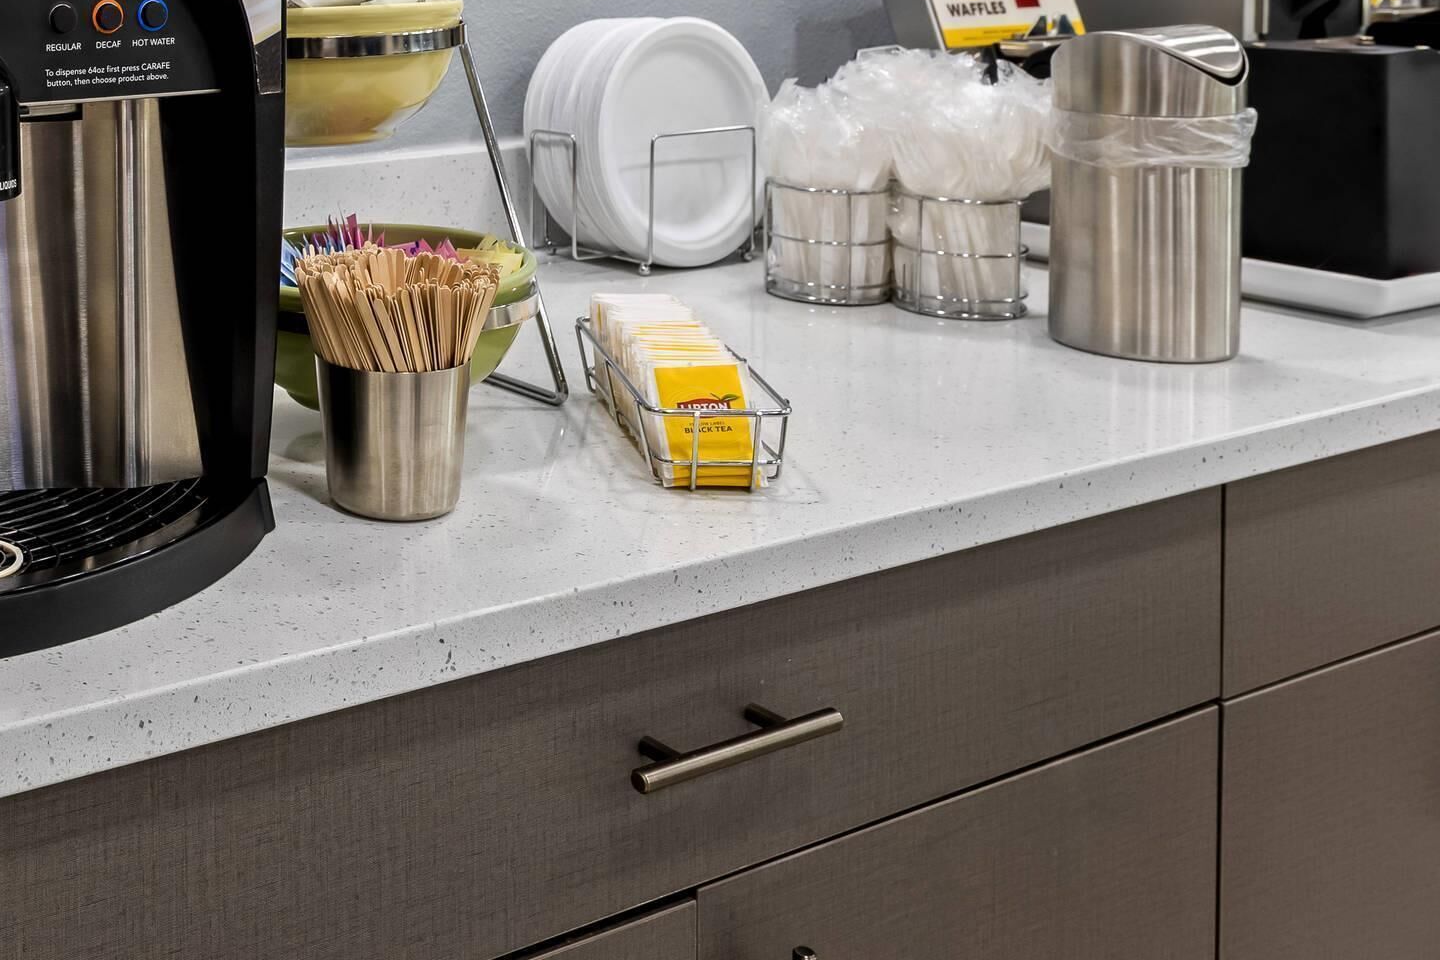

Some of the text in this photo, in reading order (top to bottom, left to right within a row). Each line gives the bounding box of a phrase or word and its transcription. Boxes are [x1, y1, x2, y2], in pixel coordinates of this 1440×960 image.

[946, 1, 1006, 17] WAFFLES
[46, 42, 82, 52] REGULAR
[96, 40, 122, 49] DECAF
[132, 37, 176, 47] HOT WATER
[45, 62, 171, 78] To dispense 64oz first press CARAFE
[47, 80, 73, 88] button,
[74, 78, 90, 86] then
[118, 75, 145, 84] product
[0, 179, 17, 191] LIQUIDS
